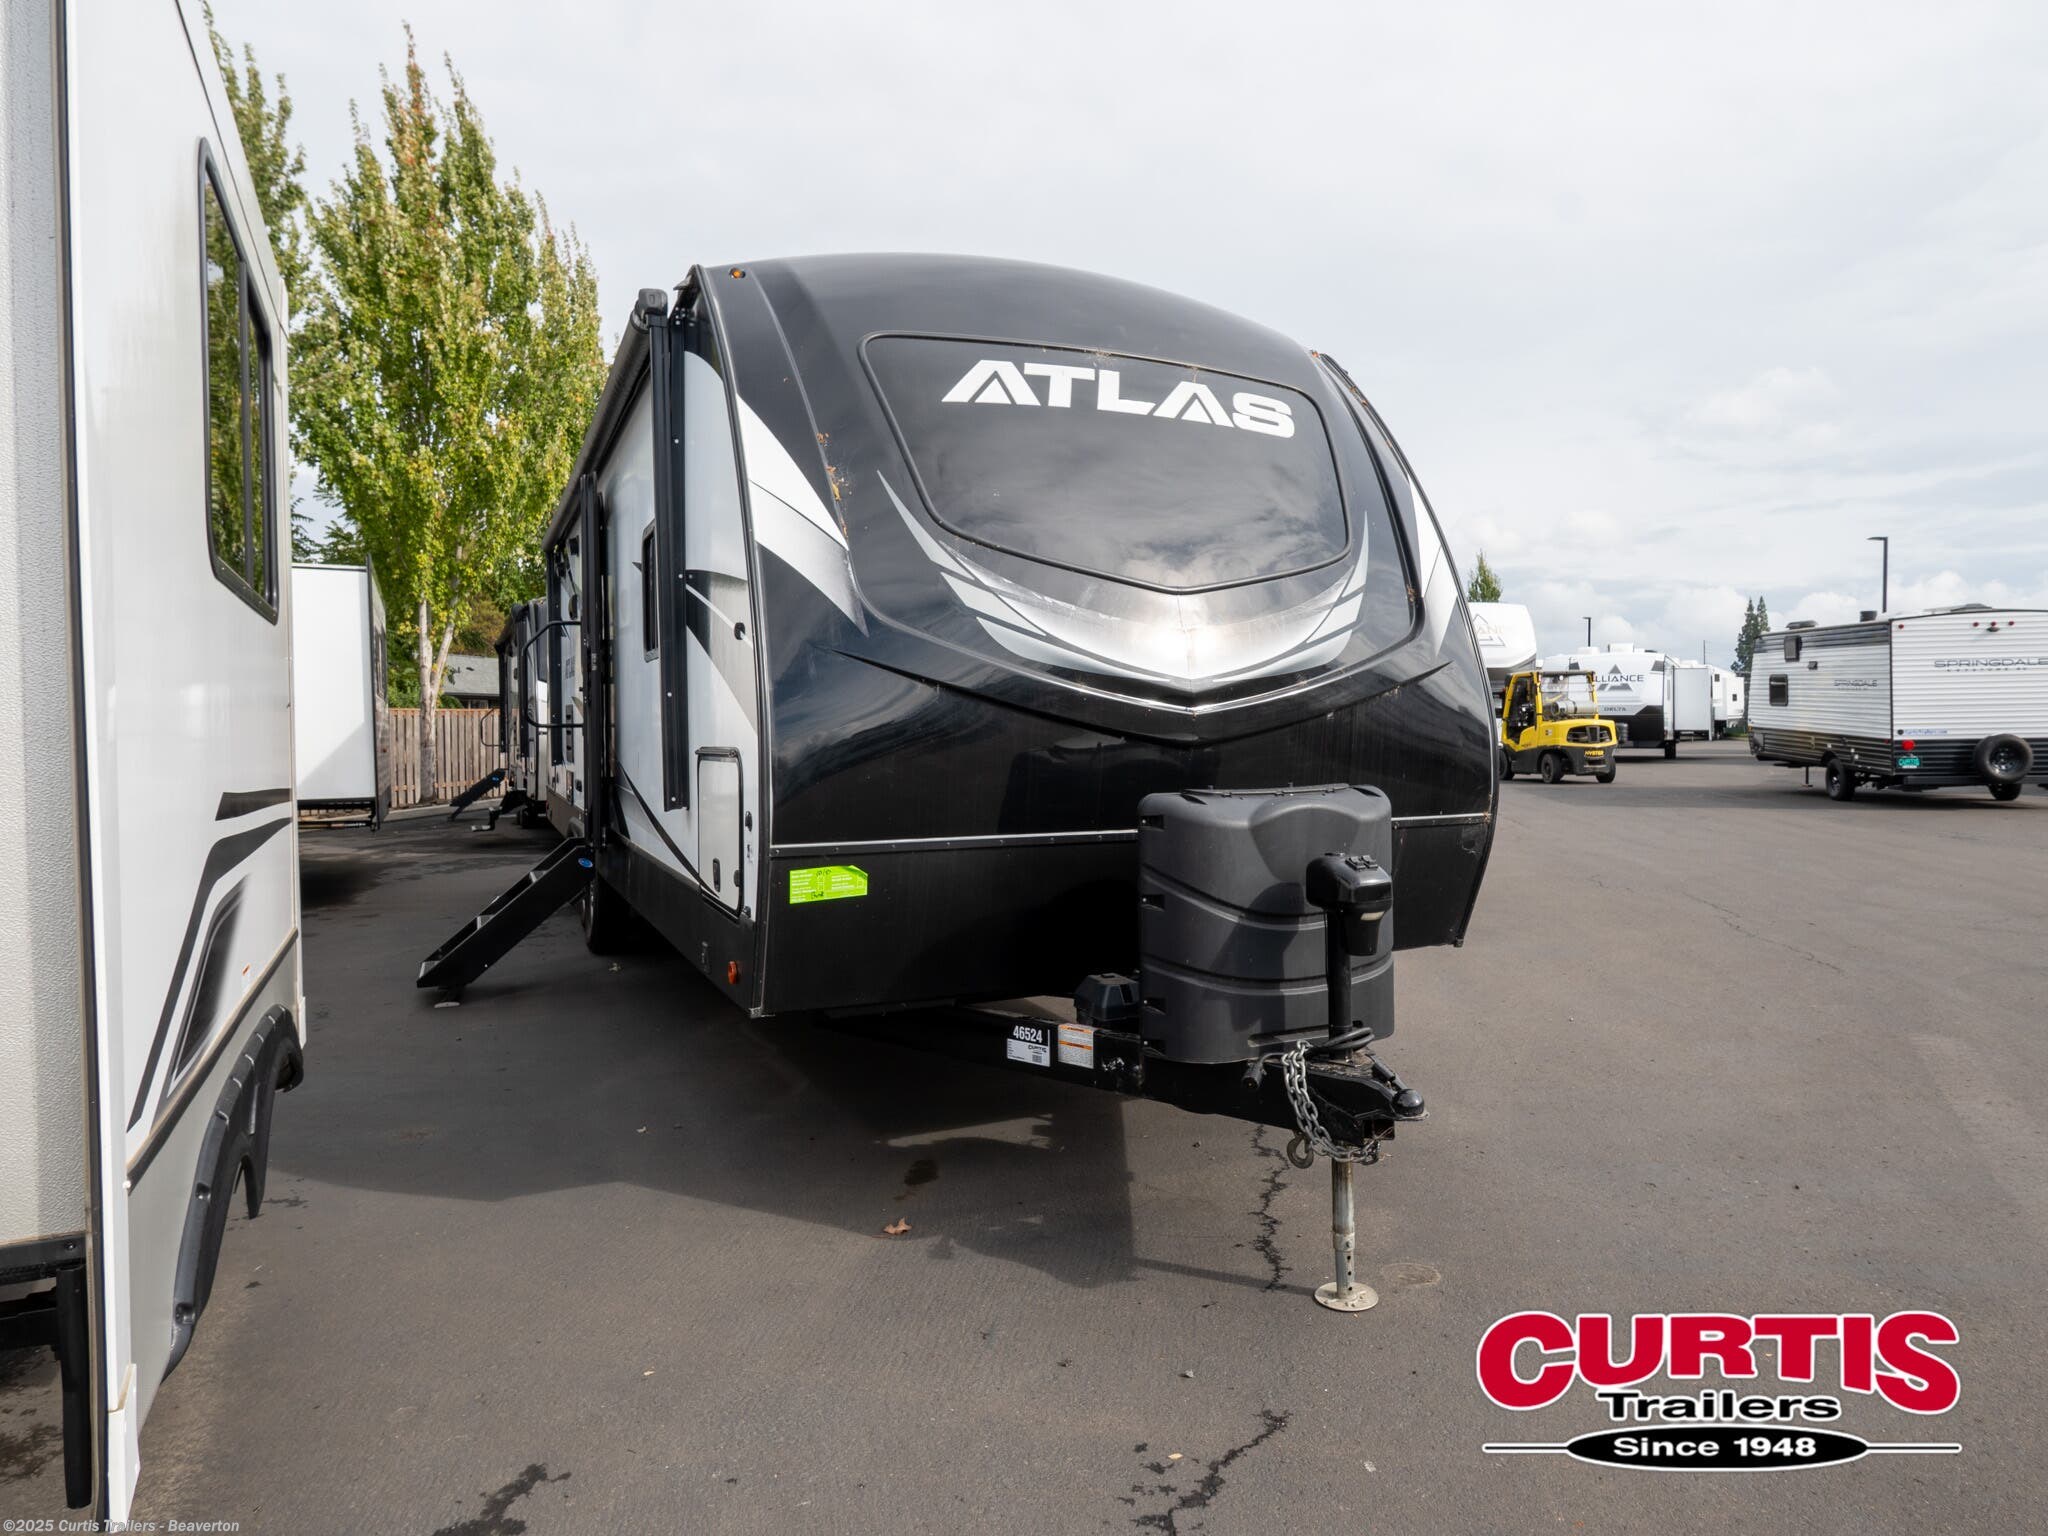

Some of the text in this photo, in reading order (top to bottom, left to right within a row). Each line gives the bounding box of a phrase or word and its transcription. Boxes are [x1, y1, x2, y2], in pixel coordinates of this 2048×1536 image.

[941, 359, 1295, 439] ATLAS
[1595, 674, 1645, 683] LLIANCE
[1013, 1025, 1043, 1043] 46524
